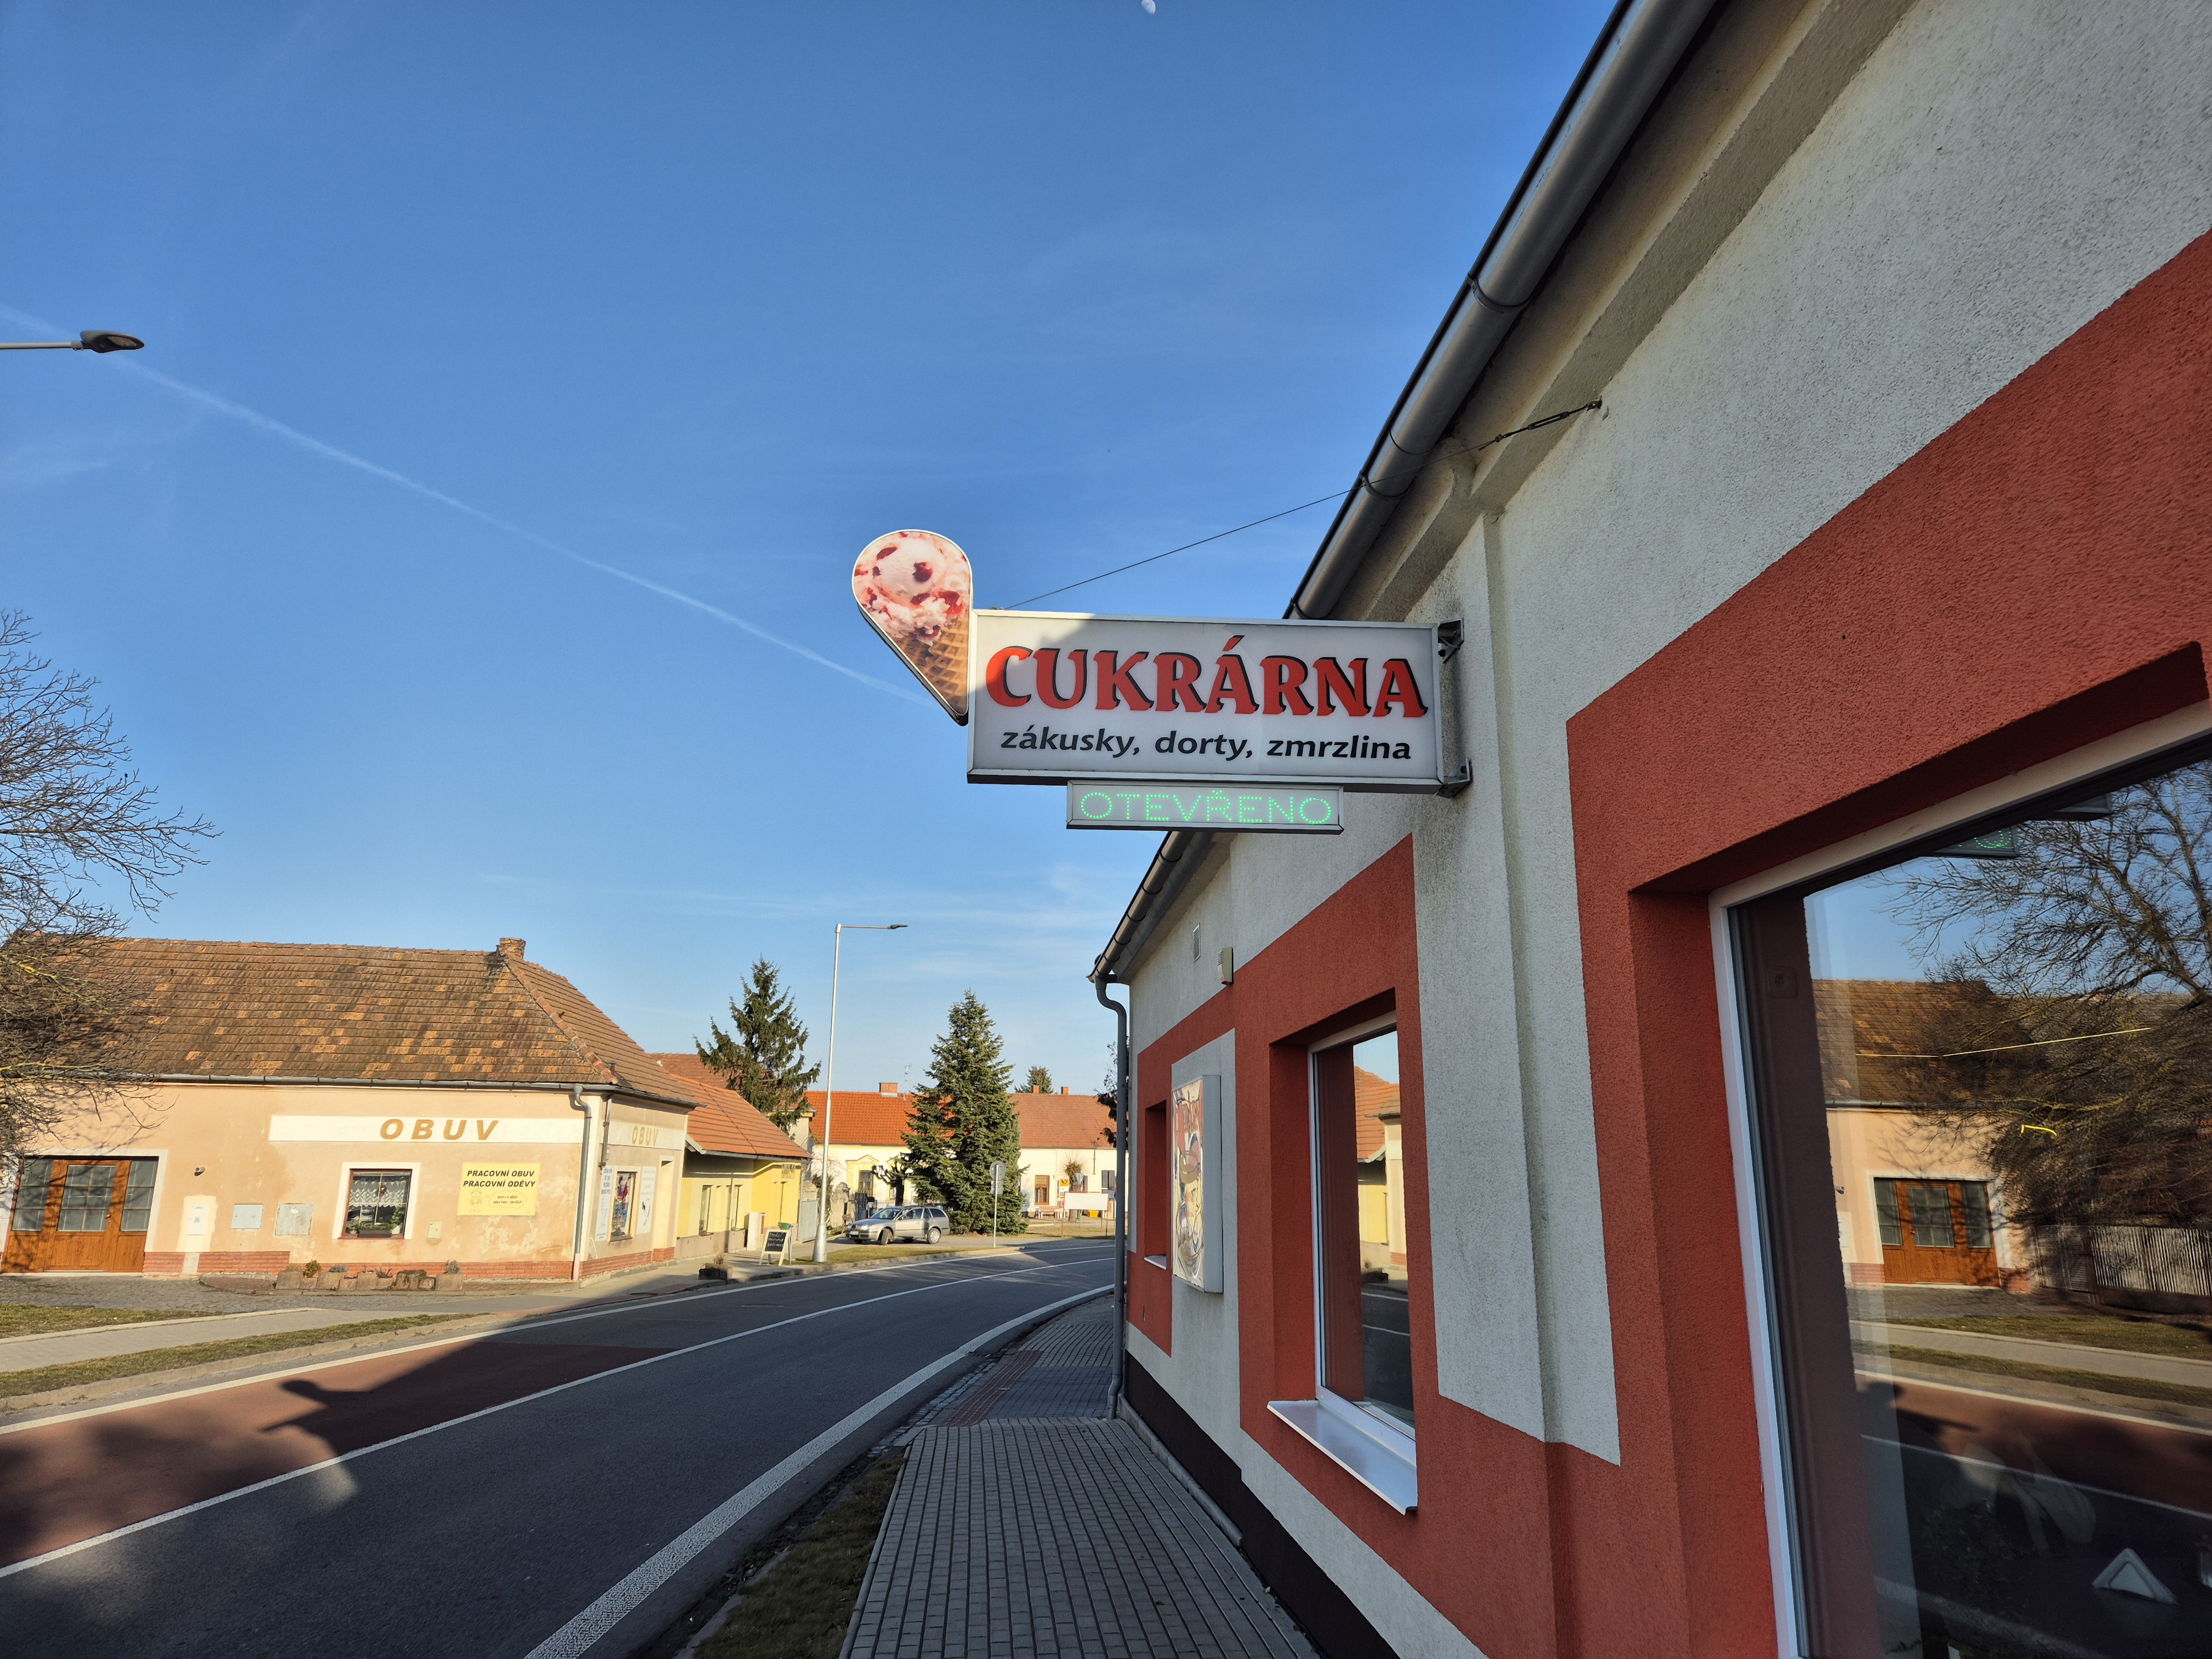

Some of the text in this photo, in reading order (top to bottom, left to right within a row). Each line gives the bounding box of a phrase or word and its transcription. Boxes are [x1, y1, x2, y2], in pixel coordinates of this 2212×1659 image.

[985, 635, 1428, 718] CUKRÁRNA
[1000, 724, 1412, 761] zákusky, dorty, zmrzlina
[1080, 790, 1332, 825] OTEVŘENO
[379, 1118, 499, 1141] OBUV
[632, 1125, 659, 1146] OBUV
